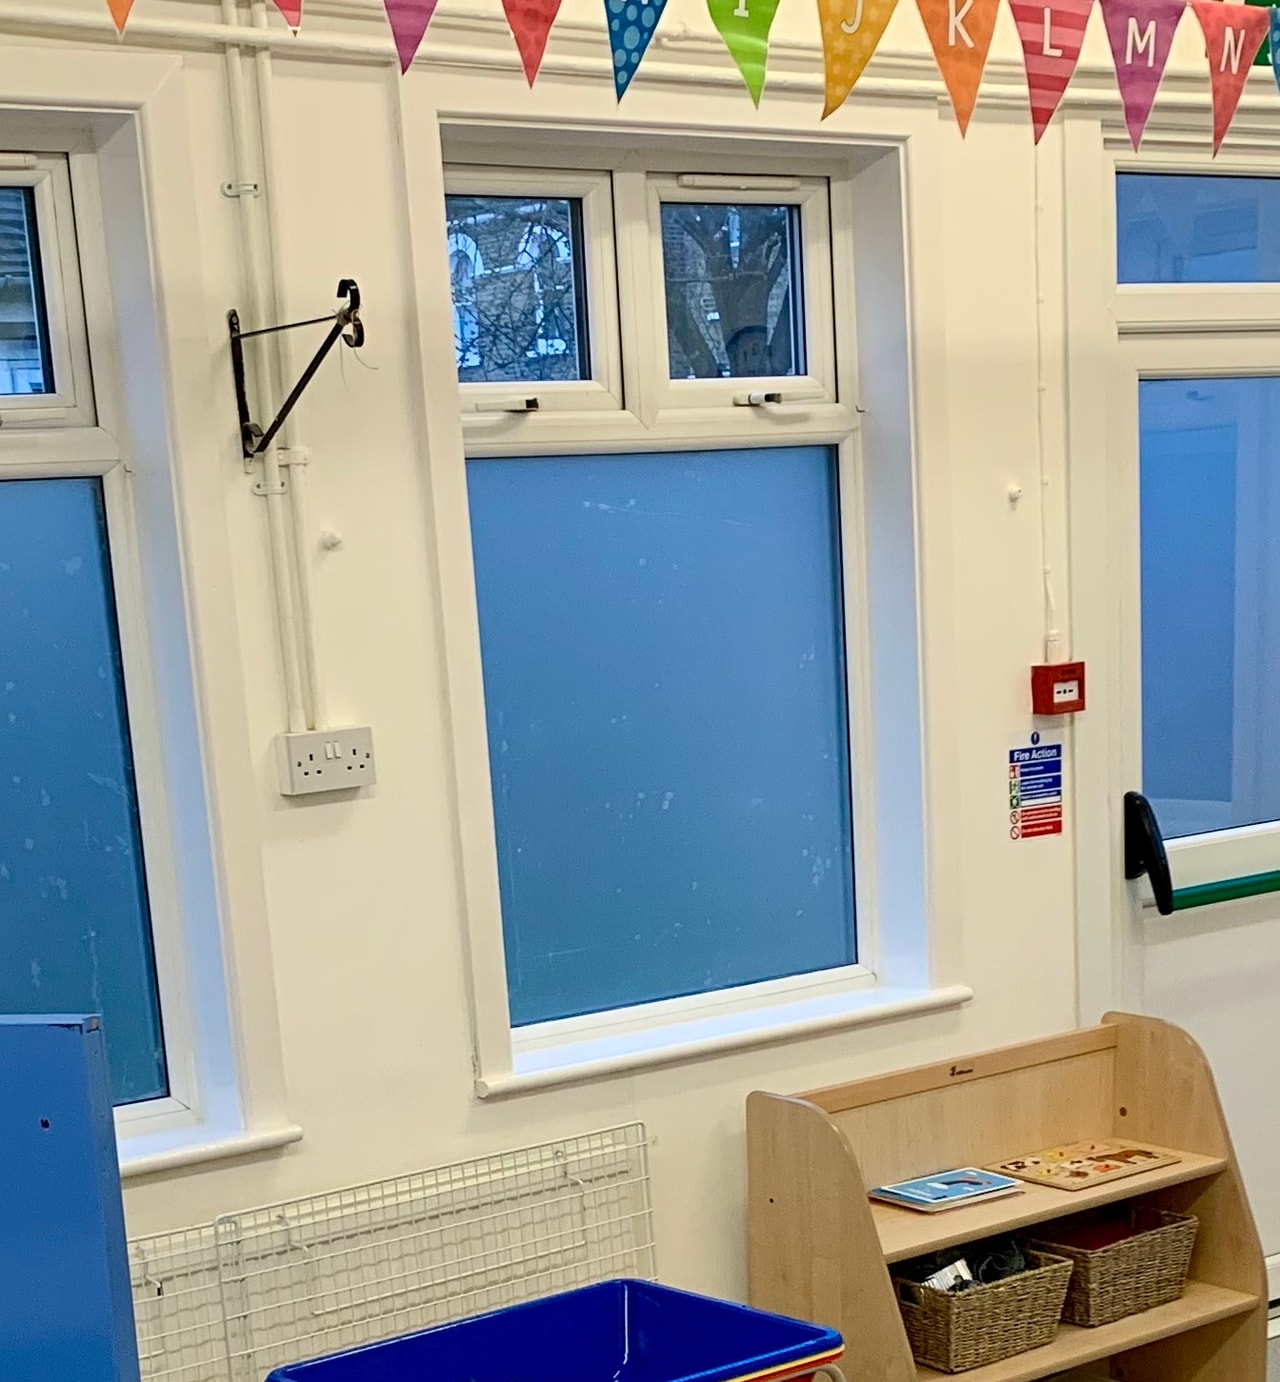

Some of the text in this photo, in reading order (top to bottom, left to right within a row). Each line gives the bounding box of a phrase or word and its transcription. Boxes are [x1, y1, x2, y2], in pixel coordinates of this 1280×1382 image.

[841, 0, 863, 34] J
[947, 0, 975, 48] K
[1042, 7, 1063, 57] L
[1125, 17, 1157, 68] M
[1219, 27, 1245, 75] N
[1014, 748, 1057, 761] Fire Action
